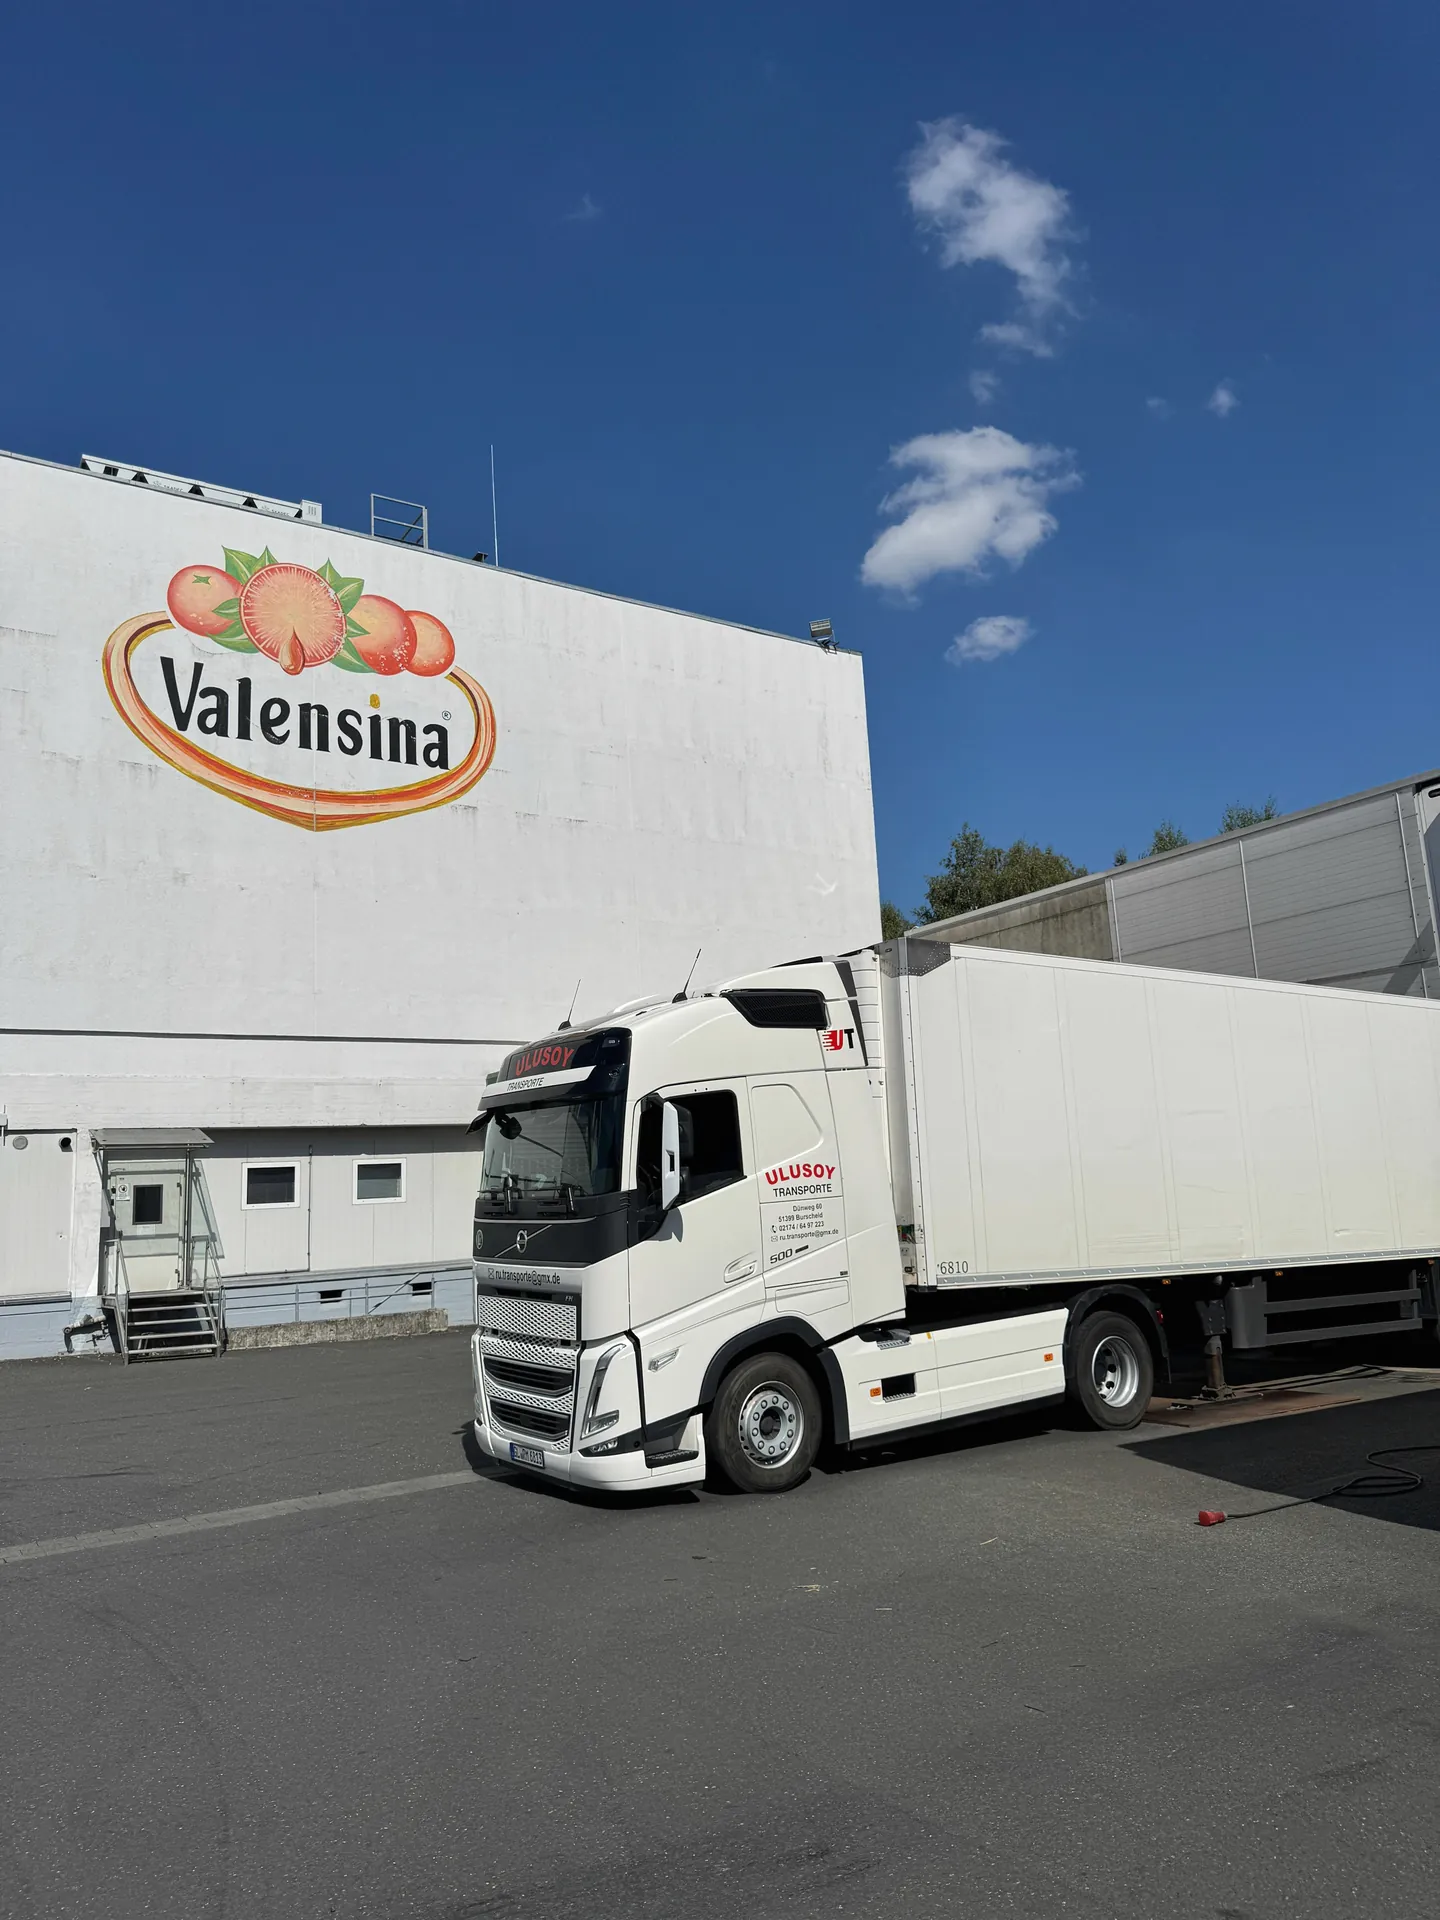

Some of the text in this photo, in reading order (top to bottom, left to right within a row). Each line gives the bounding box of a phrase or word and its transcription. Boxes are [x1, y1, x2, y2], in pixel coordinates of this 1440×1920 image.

[160, 656, 450, 770] Valensina
[515, 1046, 575, 1076] ULUSOY
[507, 1077, 544, 1091] TRANSPORTE
[765, 1163, 836, 1185] ULUSOY
[773, 1184, 832, 1197] TRANSPORTE
[796, 1212, 823, 1221] Burscheid
[780, 1229, 839, 1240] ru.transporte@gmx.de
[770, 1248, 793, 1264] 500
[940, 1261, 969, 1274] 6810
[496, 1269, 560, 1286] ru.transporte@gmx.de
